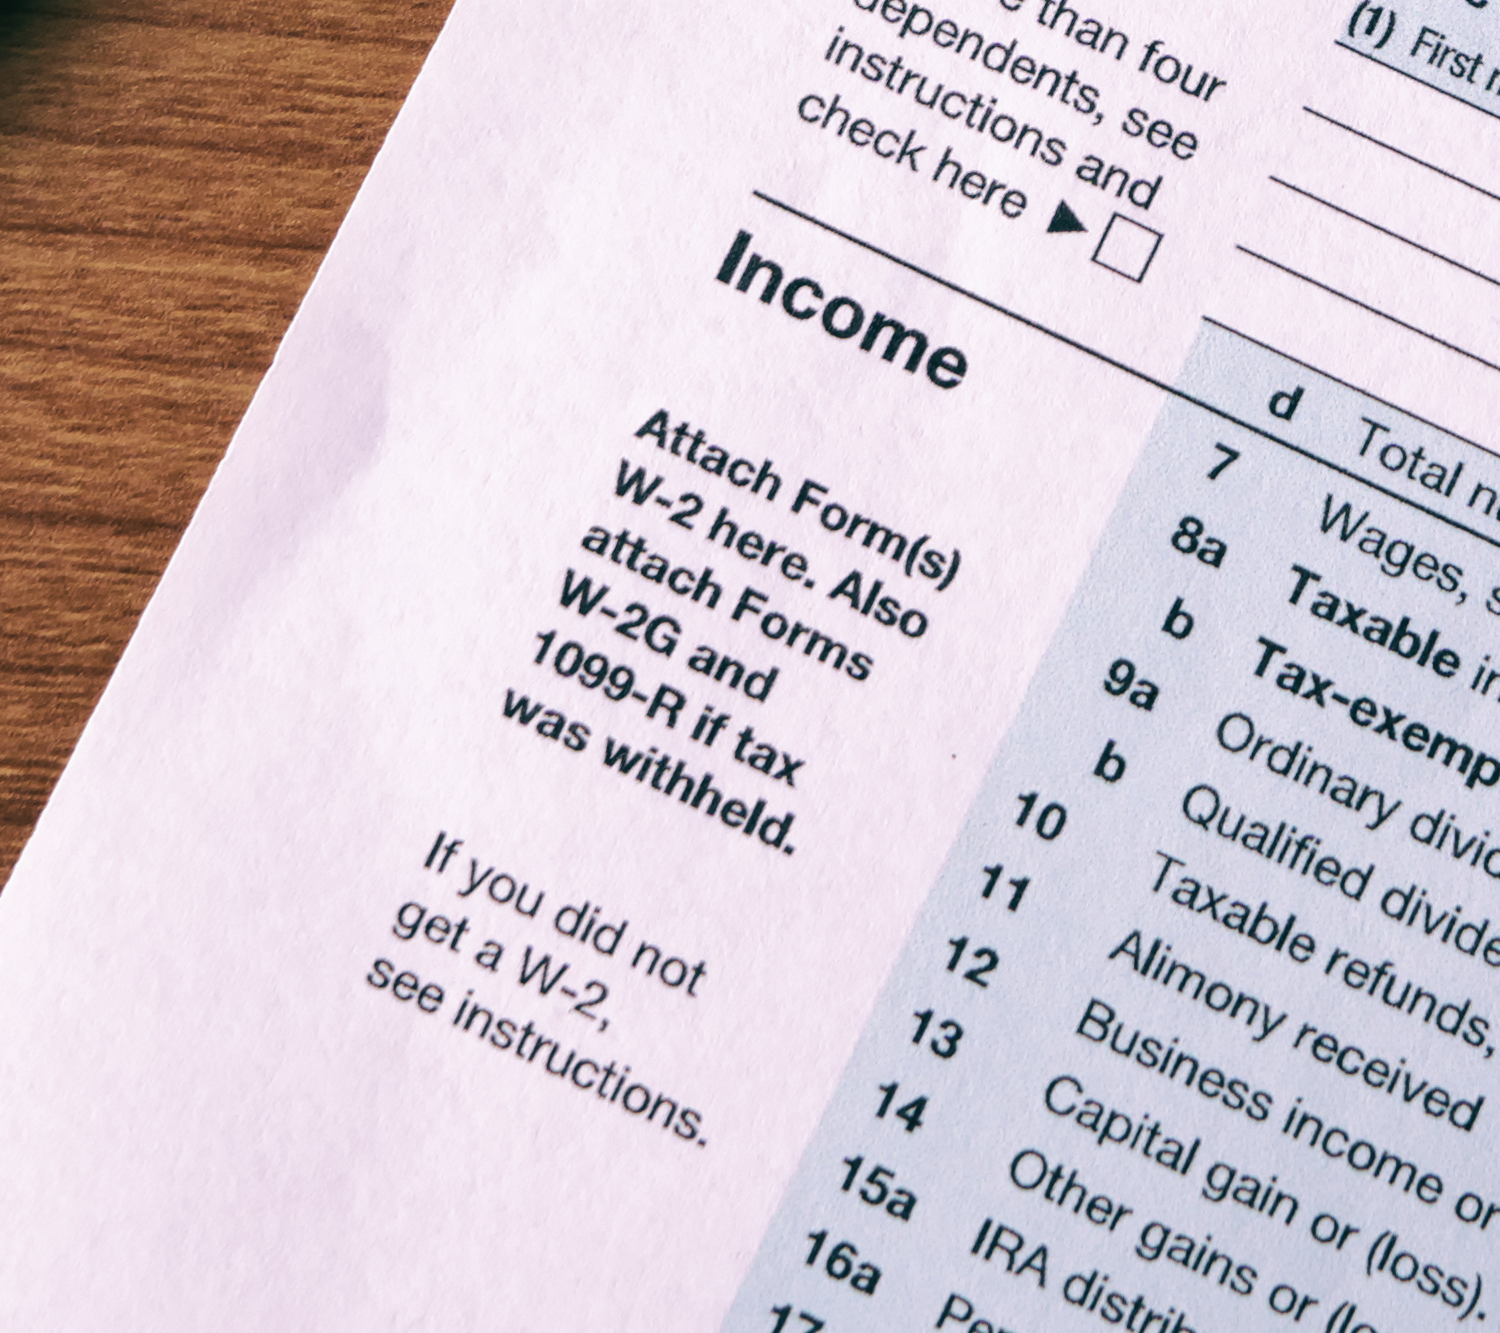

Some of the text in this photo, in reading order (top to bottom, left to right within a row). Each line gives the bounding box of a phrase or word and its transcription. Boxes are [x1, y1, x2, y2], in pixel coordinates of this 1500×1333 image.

[824, 25, 1164, 212] instructions and
[1121, 107, 1199, 161] see
[1137, 39, 1228, 103] four
[1409, 25, 1484, 85] First
[797, 93, 1028, 220] check here
[714, 228, 969, 391] Income
[614, 457, 929, 639] W-2 here. Also
[633, 408, 962, 593] Attach Form(s)
[558, 567, 780, 704] W-2G and
[580, 525, 874, 682] attach Forms
[502, 688, 796, 857] was withheld.
[533, 629, 806, 789] 1099-R if tax
[1092, 738, 1127, 784] b
[1181, 783, 1376, 902] Qualified
[391, 901, 610, 1033] get a W-2,
[423, 831, 707, 998] If you did not
[1015, 791, 1068, 842] 10
[1151, 849, 1317, 964] Taxable
[1323, 947, 1495, 1060] refunds,
[365, 957, 707, 1148] see instructions.
[945, 935, 1001, 990] 12
[1075, 997, 1274, 1123] Business
[1281, 1096, 1444, 1206] income
[980, 863, 1486, 1133] 11 Alimony received
